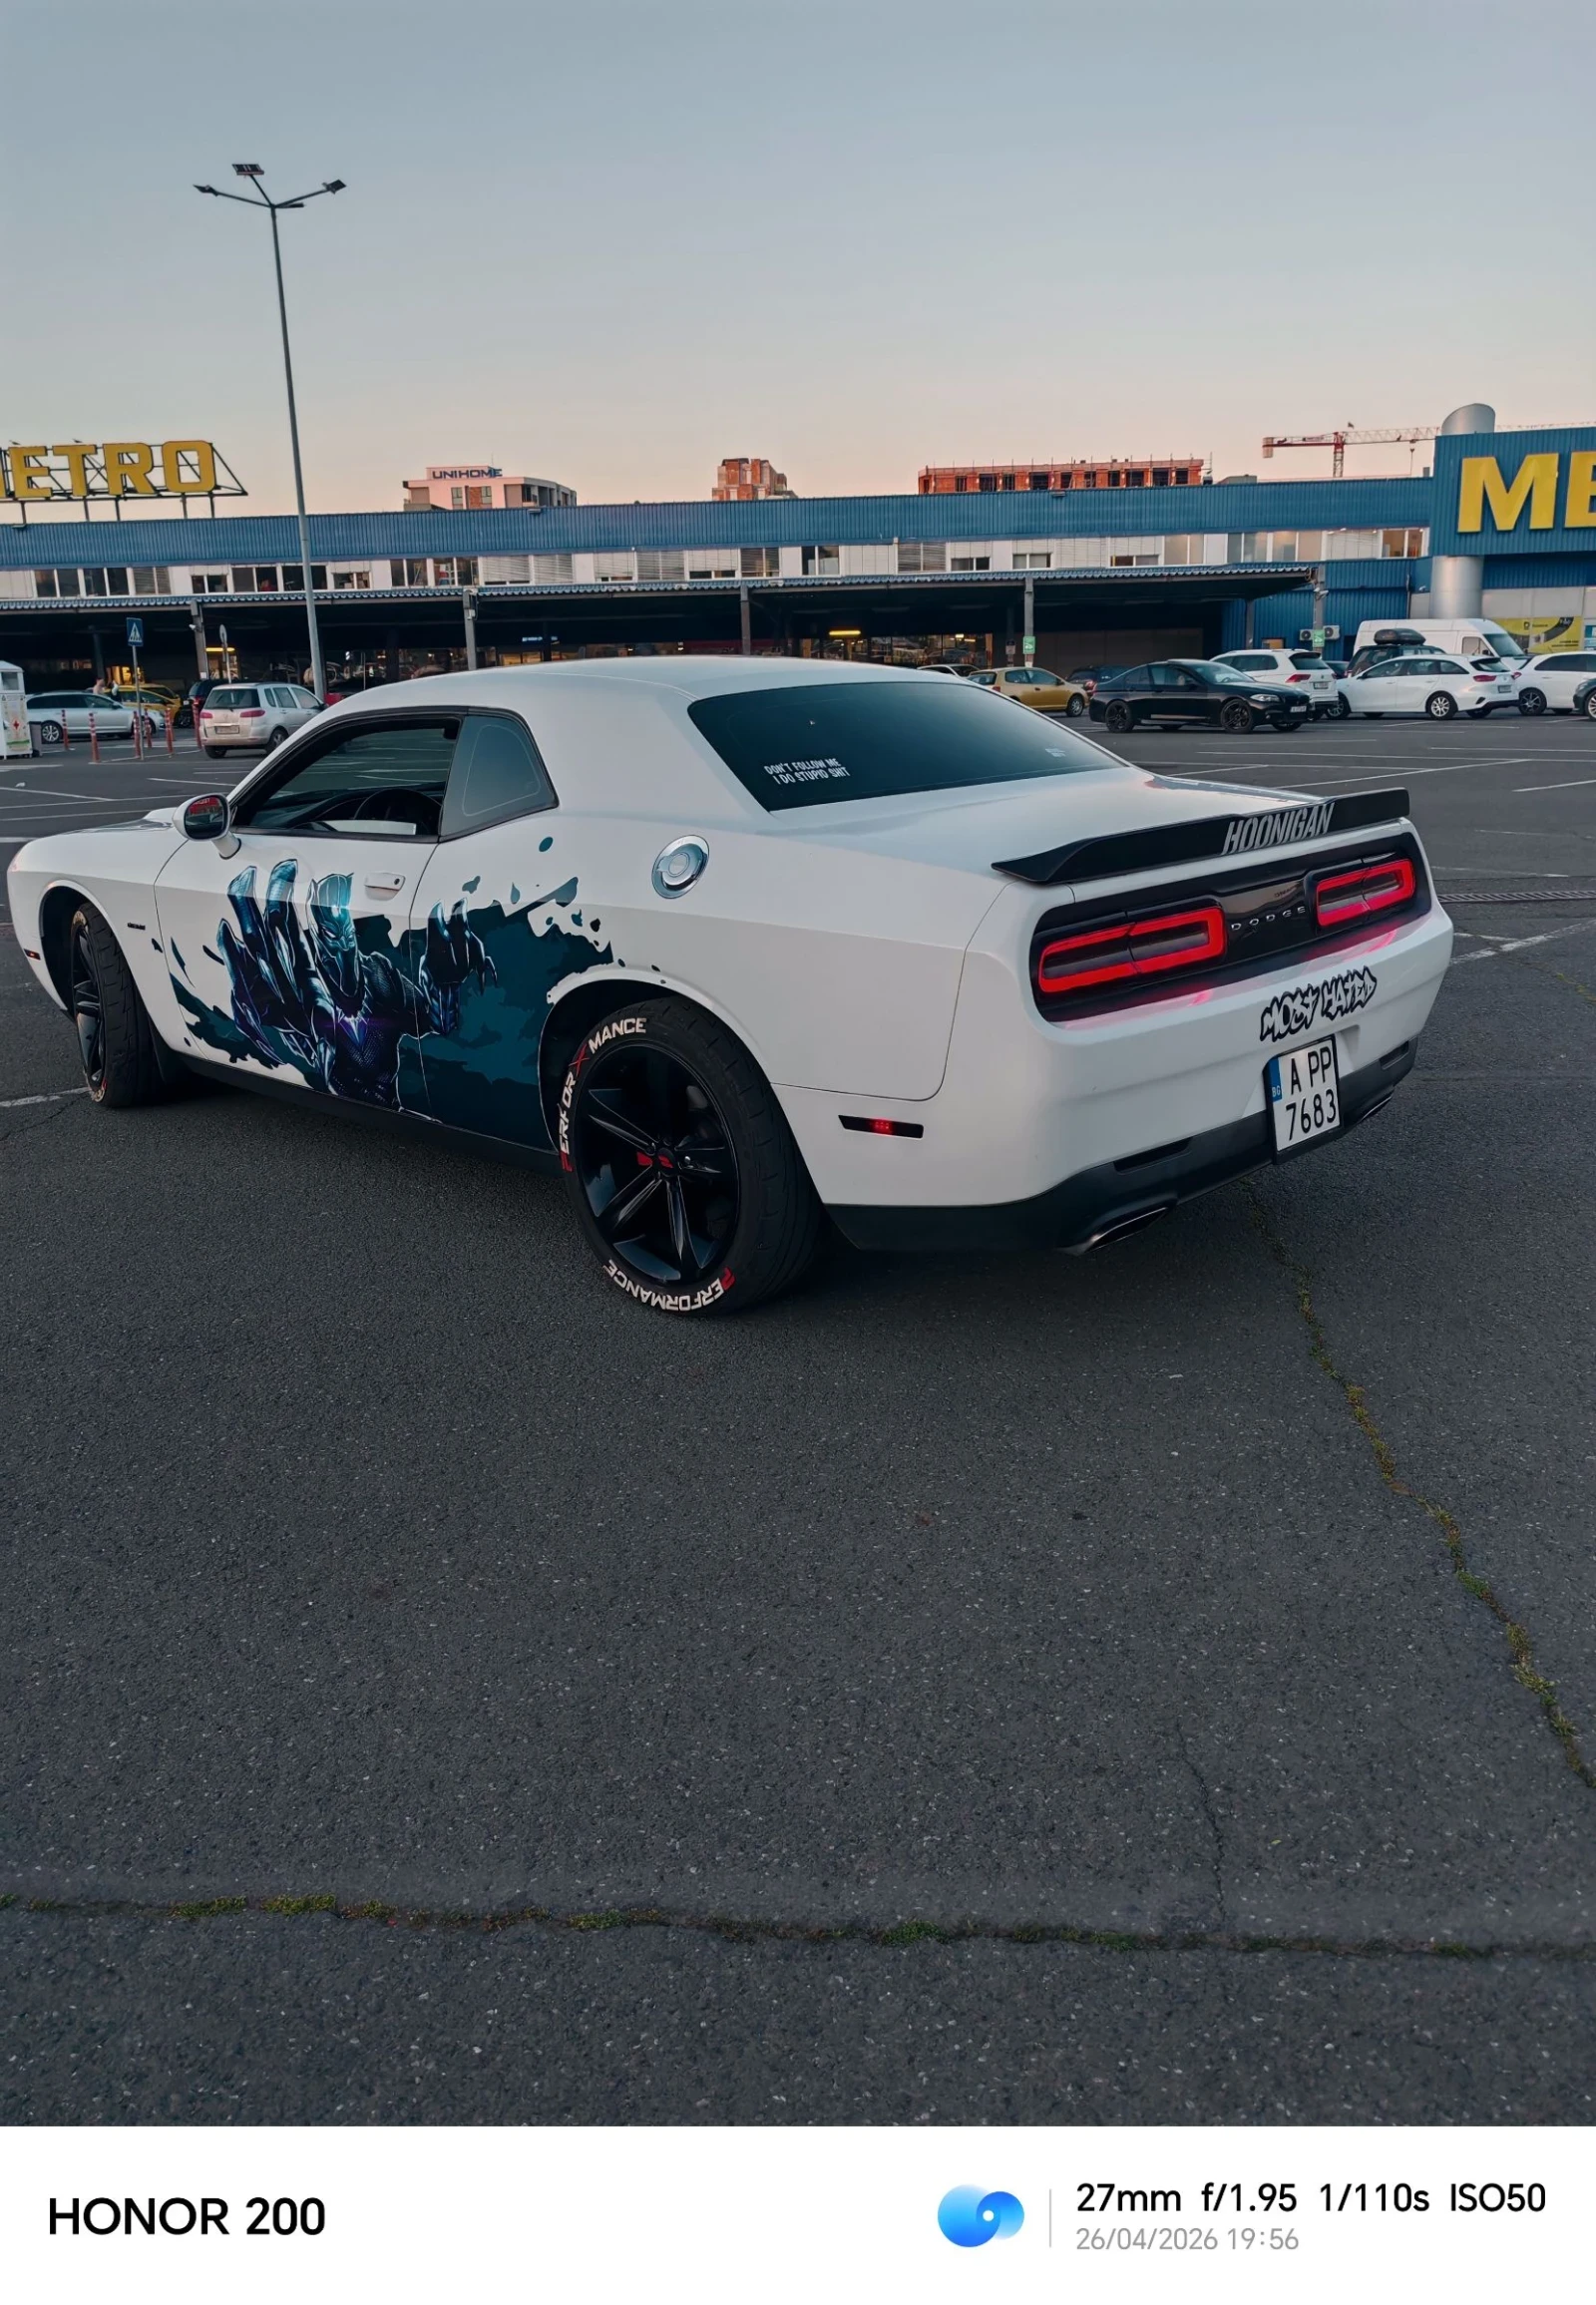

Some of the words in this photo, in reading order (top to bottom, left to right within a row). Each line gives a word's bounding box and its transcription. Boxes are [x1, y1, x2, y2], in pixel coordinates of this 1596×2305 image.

[0, 440, 216, 499] ETRO
[432, 468, 503, 480] UNIHOME
[764, 762, 793, 775] DON'T
[791, 759, 827, 771] FOLLOW
[772, 775, 781, 785] I
[778, 773, 796, 784] DO
[794, 768, 829, 782] STUPID
[1220, 802, 1336, 856] HOONIGAN
[1231, 906, 1306, 931] DODGE
[1260, 983, 1320, 1042] MOST
[1321, 965, 1378, 1021] HATED
[1272, 1085, 1281, 1098] BG
[1290, 1057, 1302, 1095] A
[1307, 1045, 1332, 1087] PP
[1285, 1088, 1337, 1141] 7683
[602, 1259, 736, 1312] PERFORMANCE
